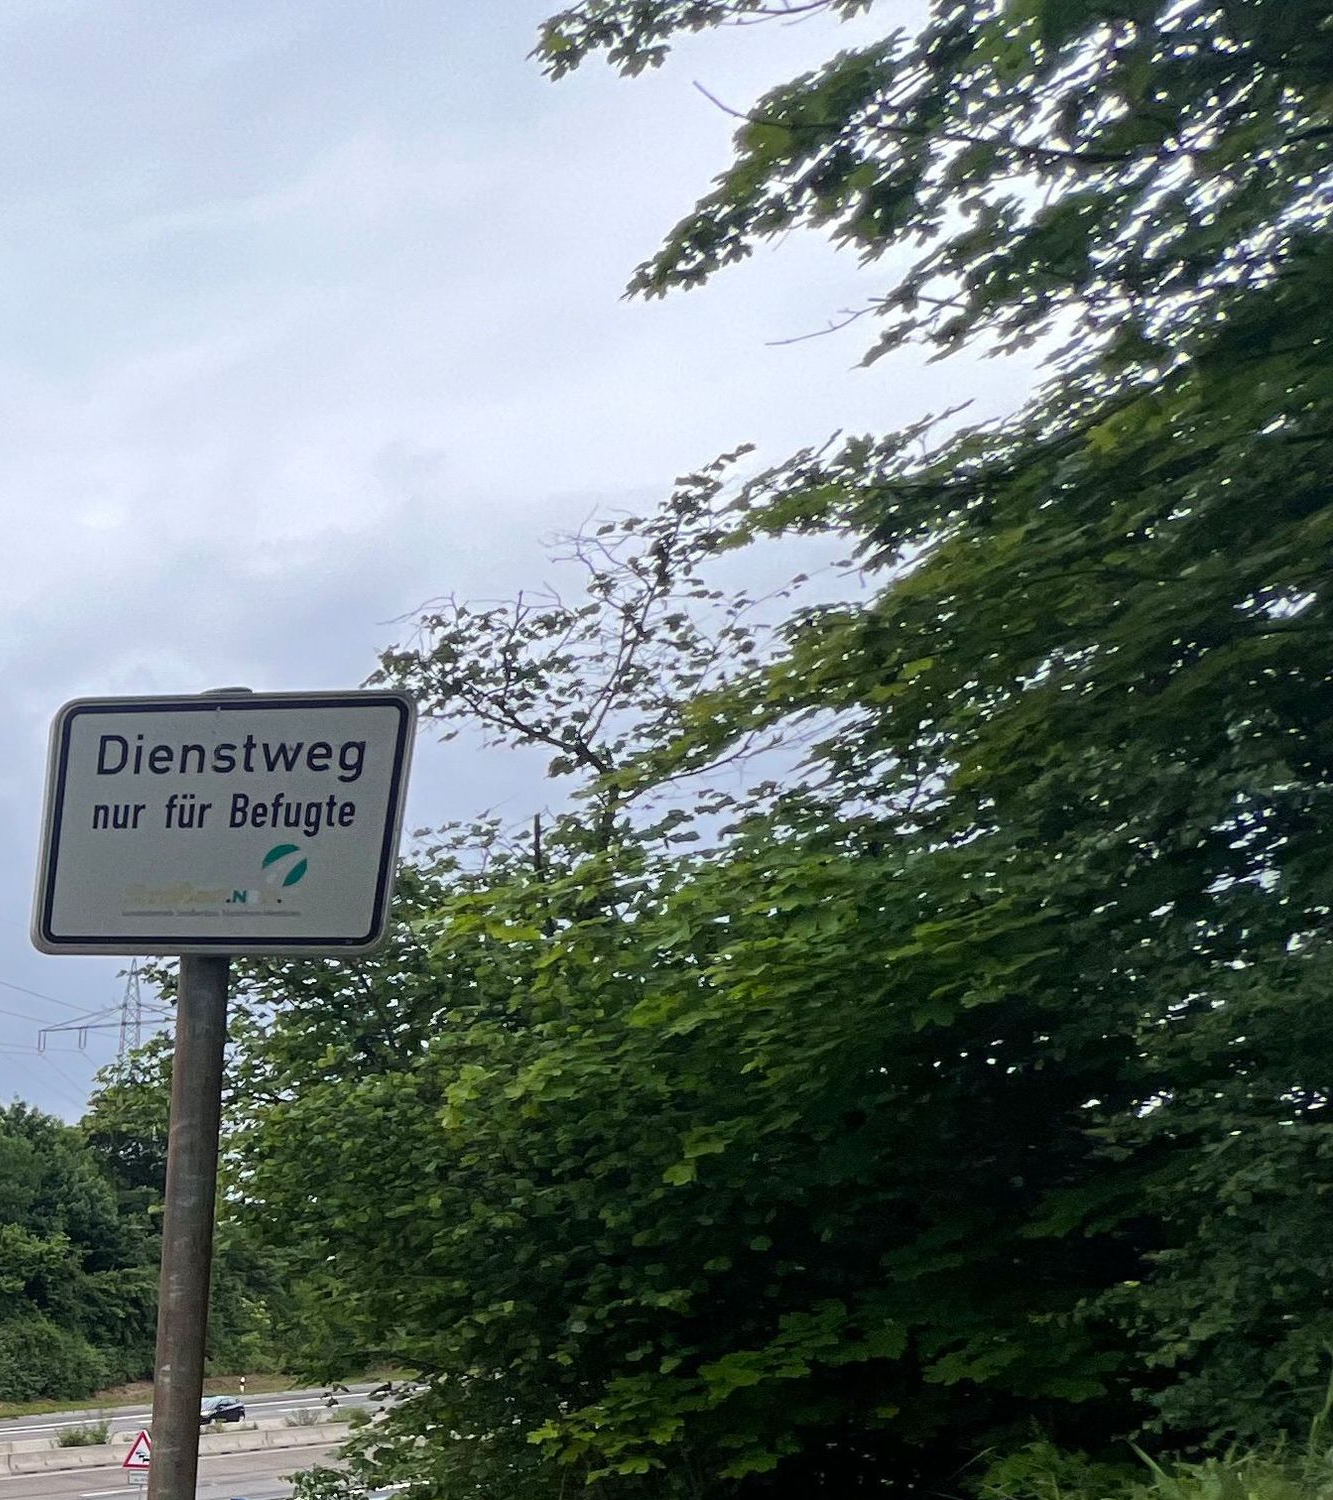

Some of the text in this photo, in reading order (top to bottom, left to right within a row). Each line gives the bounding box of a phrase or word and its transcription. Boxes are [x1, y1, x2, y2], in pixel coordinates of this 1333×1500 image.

[97, 734, 366, 782] Dienstweg
[93, 792, 356, 837] nur für Befugte
